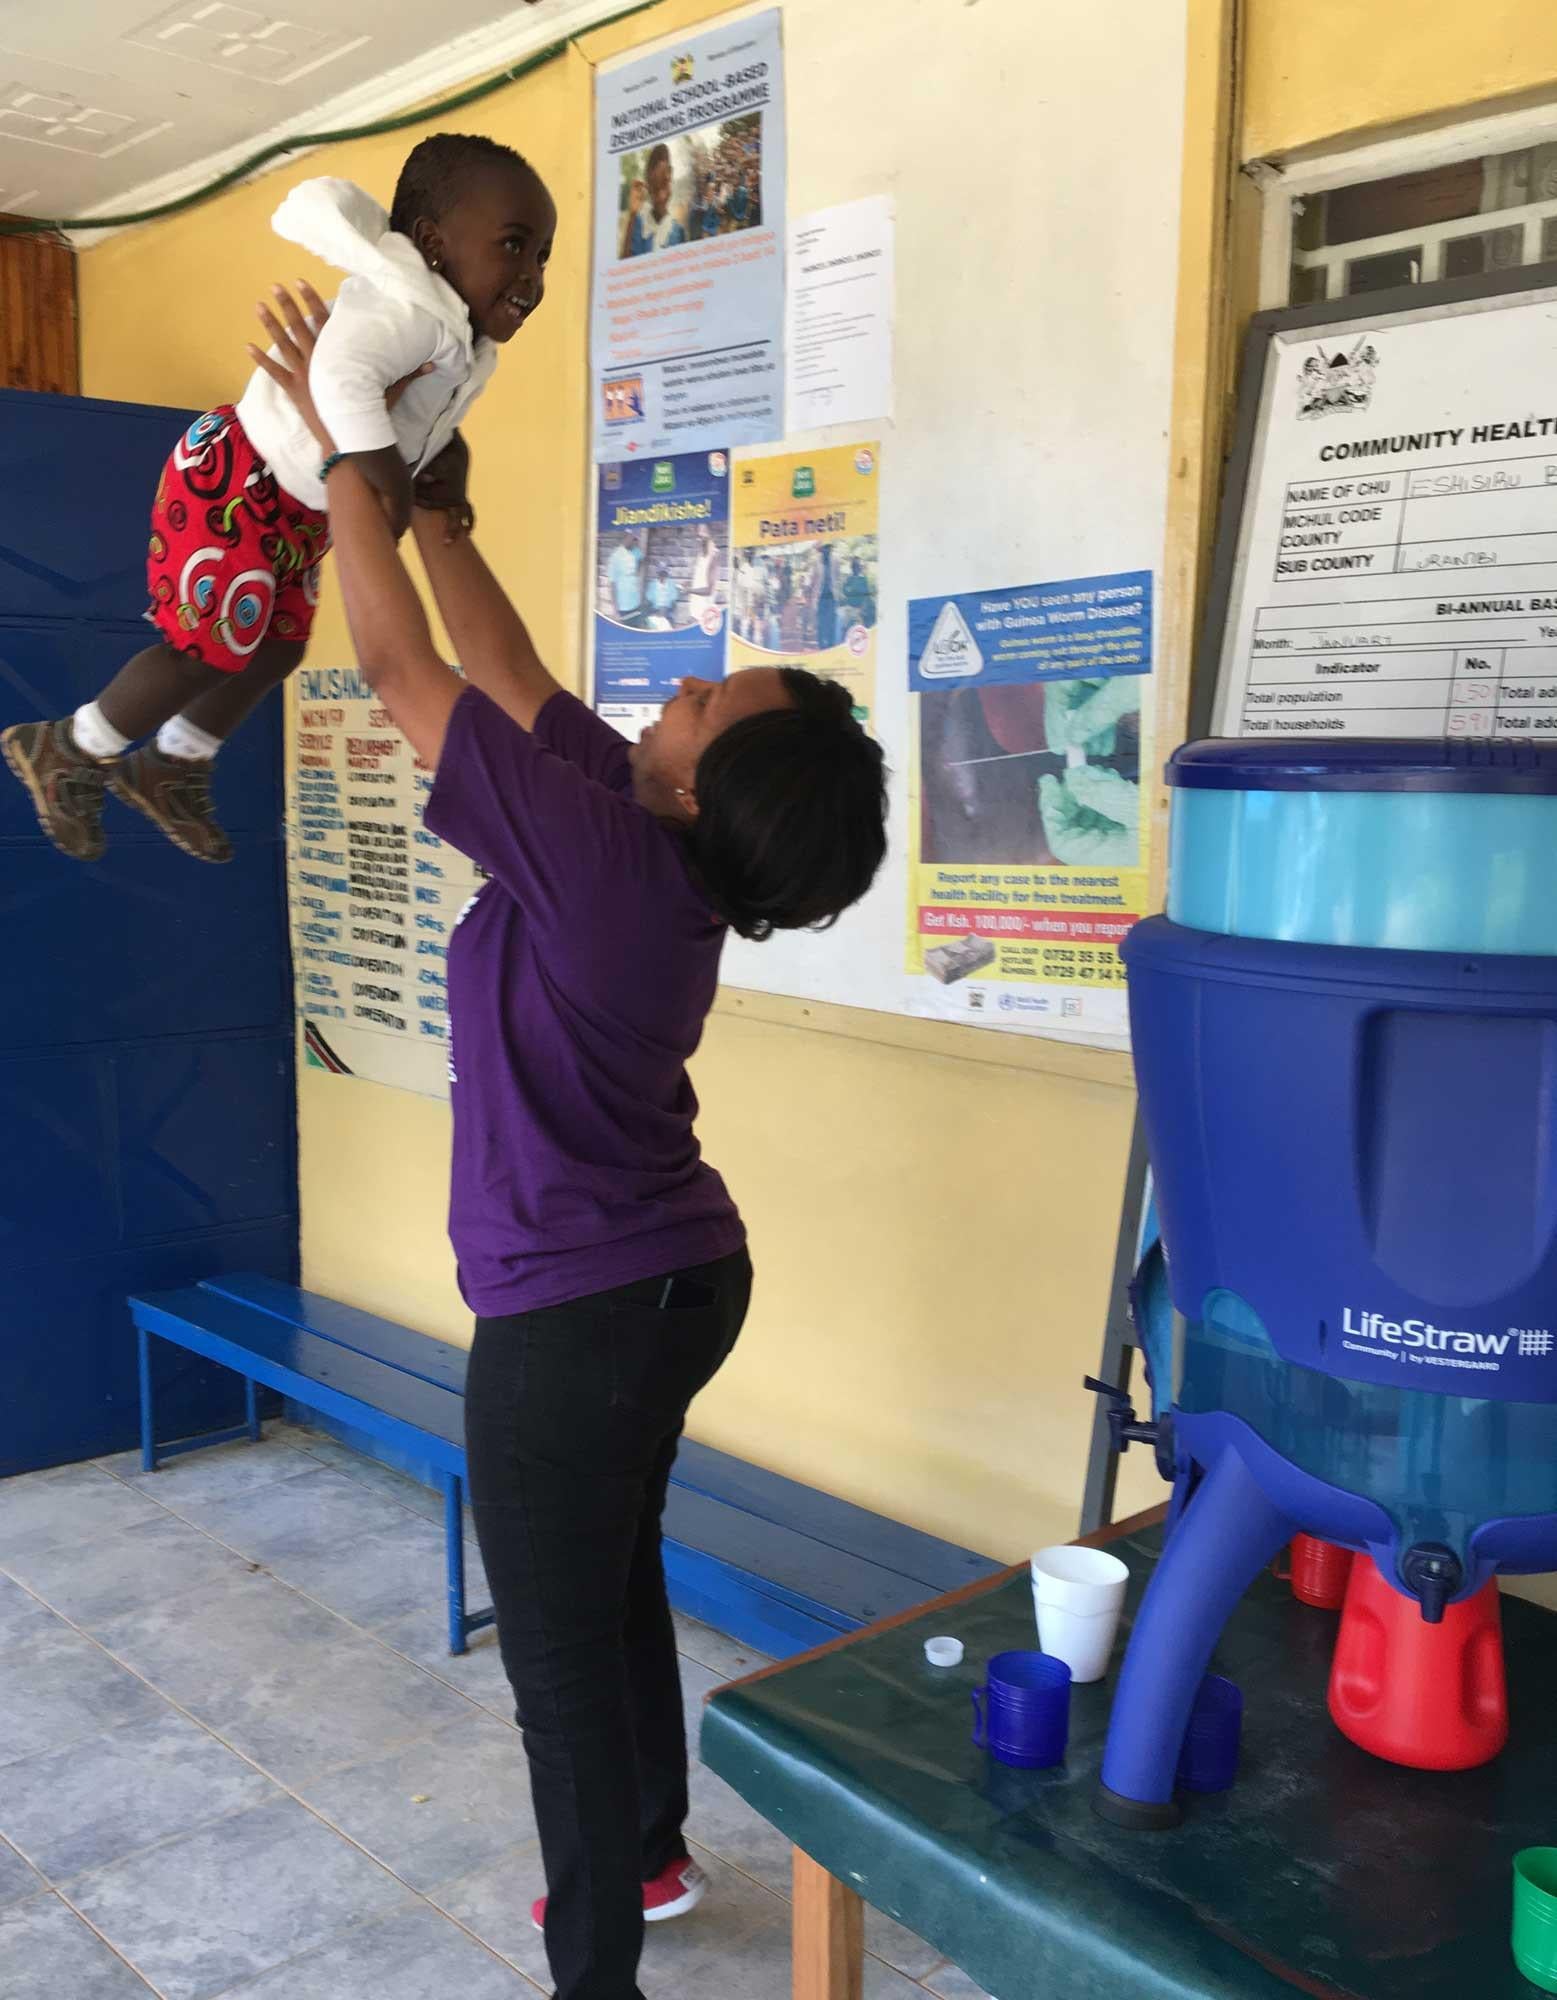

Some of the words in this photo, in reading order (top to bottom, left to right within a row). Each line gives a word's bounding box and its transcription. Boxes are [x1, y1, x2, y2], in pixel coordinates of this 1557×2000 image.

[1319, 428, 1465, 462] COMMUNITY
[1471, 417, 1557, 444] HEALT
[1286, 487, 1330, 503] NAME
[1332, 484, 1354, 498] OF
[1357, 480, 1391, 496] CHU
[1338, 507, 1383, 523] CODE
[760, 519, 798, 539] Pata
[1280, 531, 1343, 548] COUNTY
[1277, 560, 1308, 573] SUB
[1311, 554, 1374, 571] COUNTY
[1041, 595, 1071, 606] seen
[1072, 592, 1095, 603] any
[1097, 586, 1143, 602] person
[975, 618, 1001, 631] with
[1003, 616, 1046, 629] Guinea
[1047, 611, 1085, 624] Worm
[1087, 602, 1143, 619] Disease?
[1436, 600, 1524, 615] BI-ANNUAL
[1315, 662, 1382, 675] Indicator
[1465, 657, 1492, 670] No.
[1247, 692, 1276, 704] Total
[1277, 691, 1343, 706] population
[1499, 686, 1535, 699] Total
[1242, 719, 1272, 730] Total
[1274, 717, 1346, 731] households
[1496, 716, 1531, 728] Total
[938, 871, 976, 885] Report
[980, 874, 1000, 885] any
[1004, 875, 1030, 885] case
[1034, 874, 1046, 885] to
[1050, 874, 1068, 886] the
[1072, 876, 1119, 887] nearest
[931, 888, 966, 900] health
[969, 890, 1009, 904] facility
[1013, 891, 1029, 902] for
[1033, 892, 1057, 904] free
[1060, 893, 1126, 906] treatment.
[924, 912, 945, 927] Get
[1032, 917, 1067, 932] when
[1070, 922, 1093, 936] you
[1342, 1339, 1399, 1361] Community
[1424, 1355, 1500, 1372] VESTERGAARD
